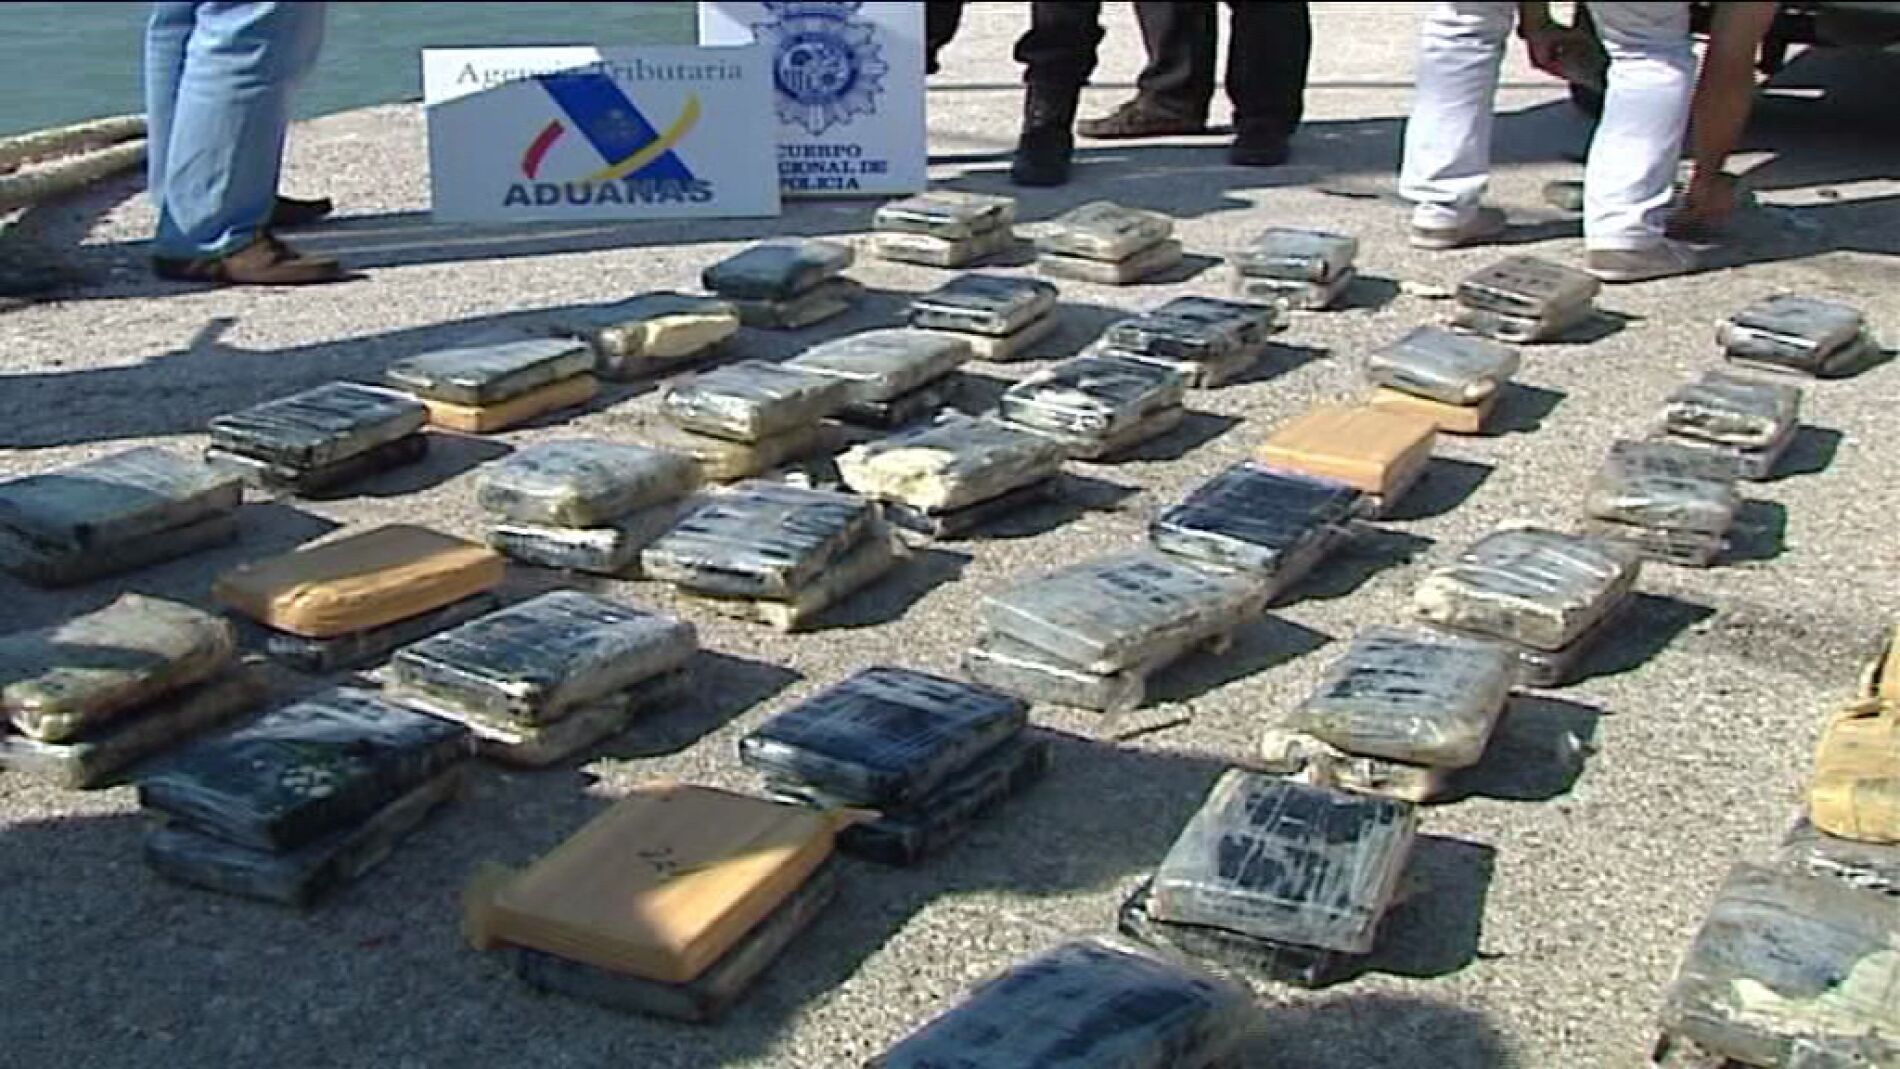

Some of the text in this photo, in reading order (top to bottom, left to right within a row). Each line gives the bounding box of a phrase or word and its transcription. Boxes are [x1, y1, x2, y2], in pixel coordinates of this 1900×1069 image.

[590, 59, 743, 82] Tributaria
[778, 160, 888, 174] CIONAL DE
[503, 180, 714, 207] ADUANAS
